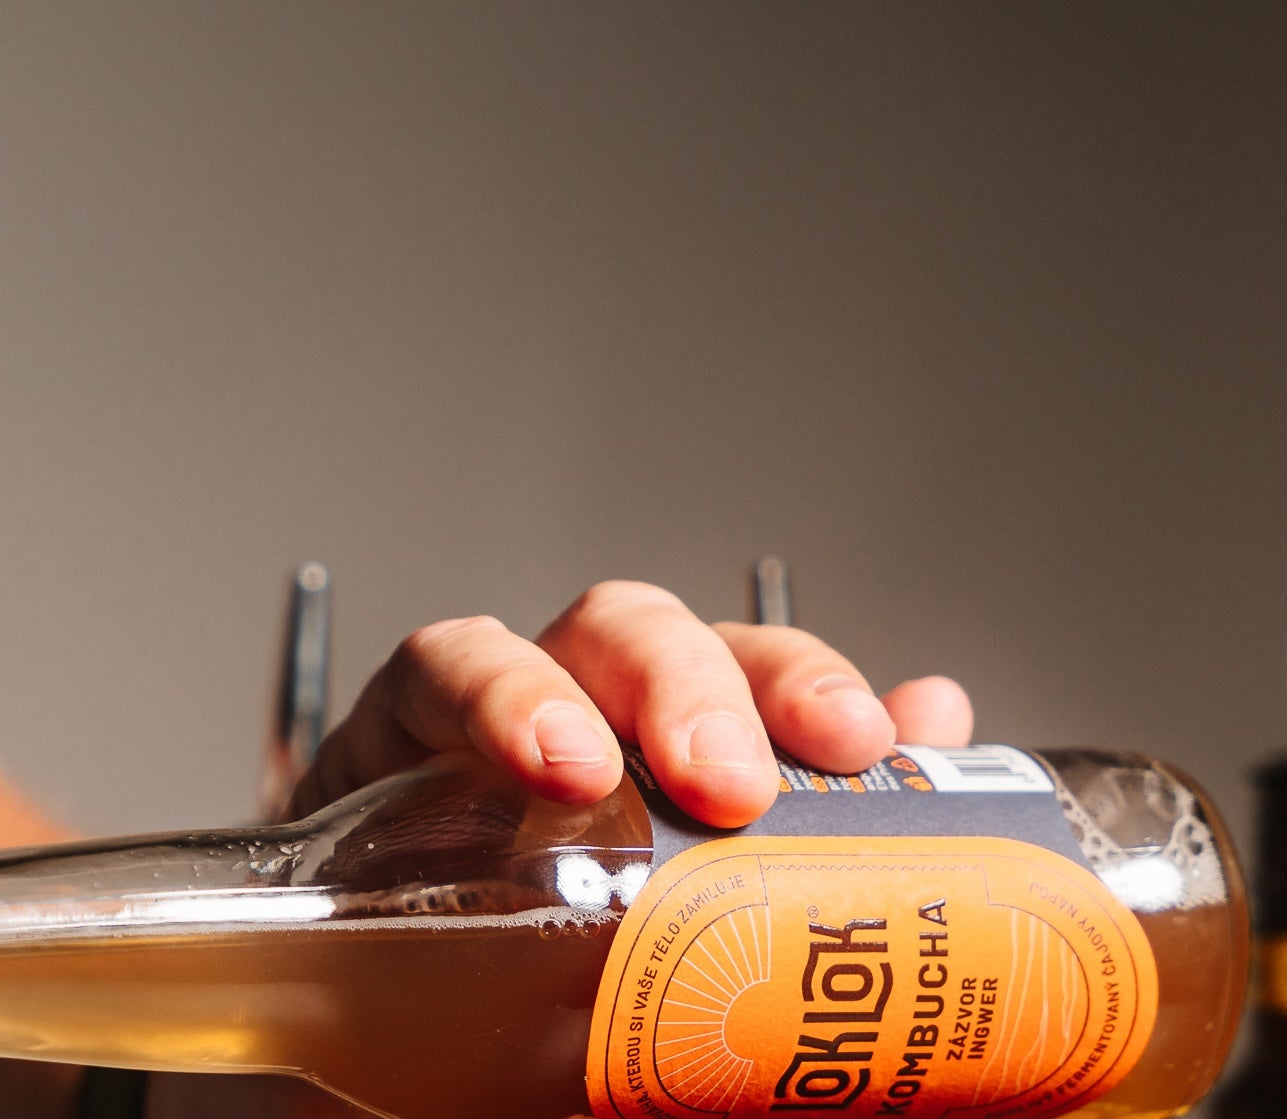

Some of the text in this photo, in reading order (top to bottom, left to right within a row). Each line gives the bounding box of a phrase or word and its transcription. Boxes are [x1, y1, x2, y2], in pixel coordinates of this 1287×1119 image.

[676, 873, 746, 925] ZAMILUJE
[650, 922, 680, 964] TĚLO
[1077, 916, 1117, 976] ČAJOVÝ
[634, 966, 658, 1010] VAŠE
[769, 918, 894, 1112] LOKLOK
[875, 897, 948, 1116] KOMBUCHA
[629, 1016, 645, 1032] SI
[946, 977, 978, 1061] ZÁZVOR
[967, 977, 999, 1060] INGWER
[1056, 980, 1120, 1096] FERMENTOVANÝ
[624, 1037, 645, 1094] KTEROU
